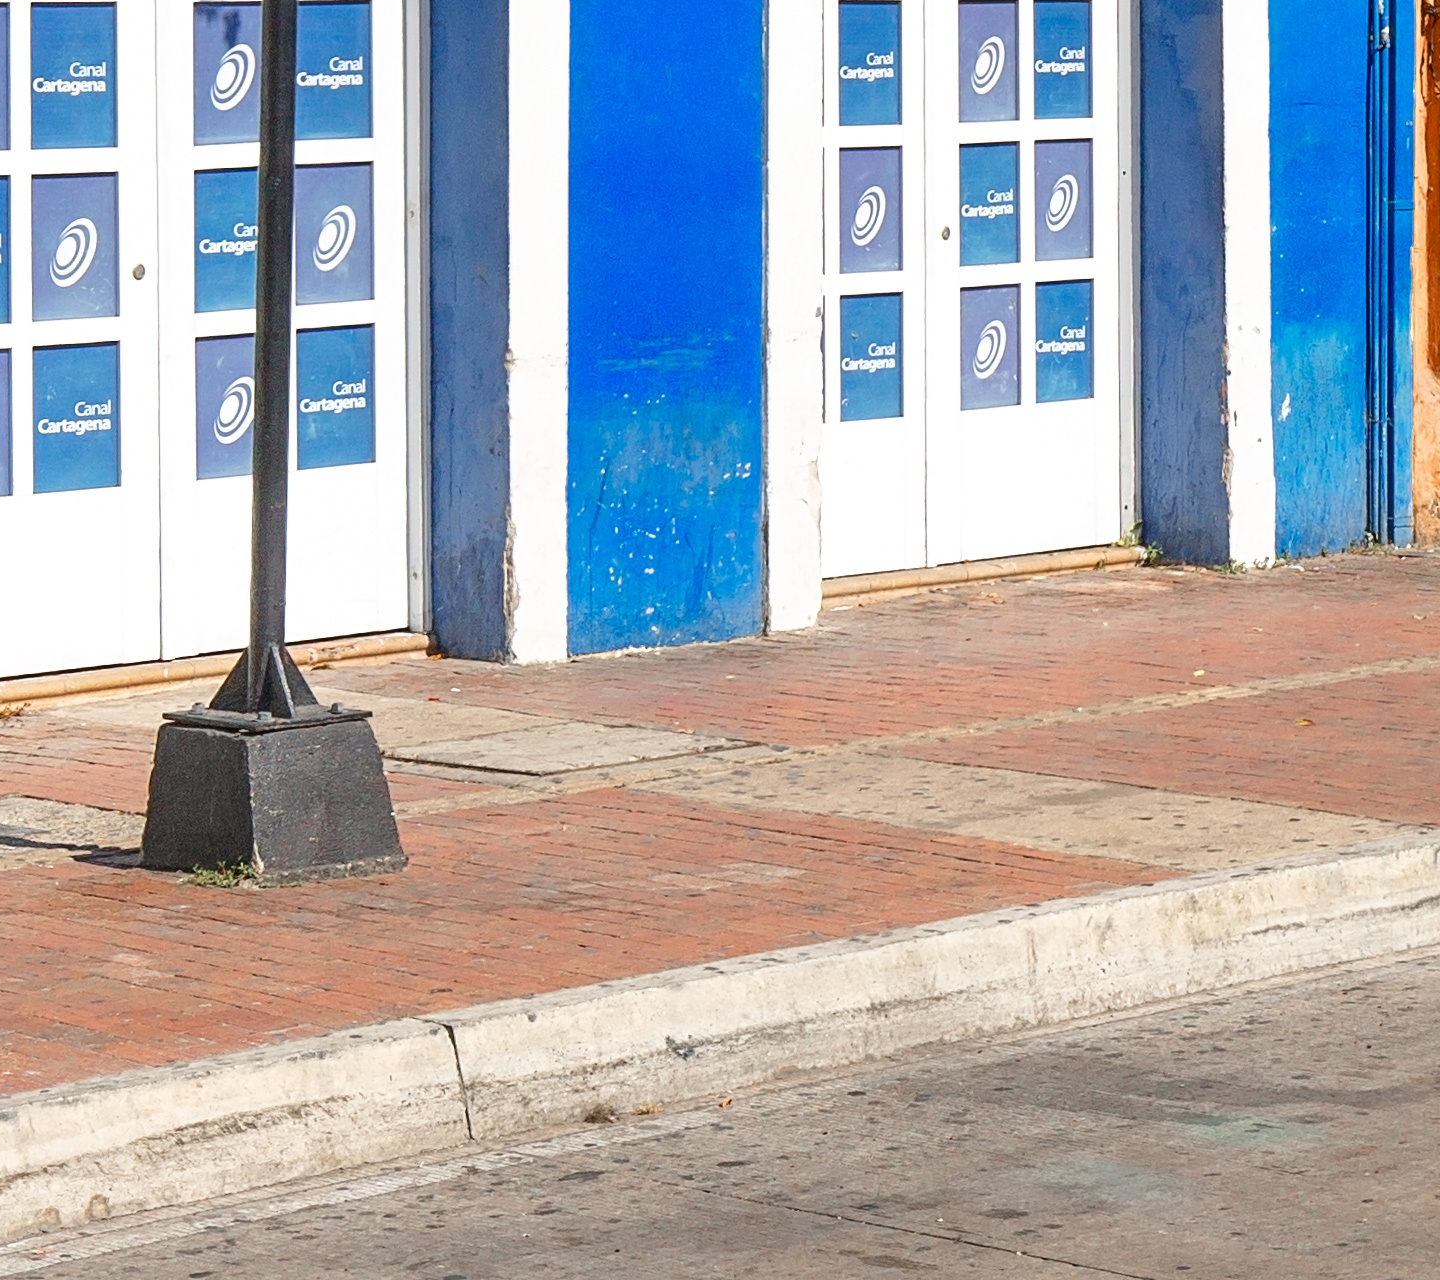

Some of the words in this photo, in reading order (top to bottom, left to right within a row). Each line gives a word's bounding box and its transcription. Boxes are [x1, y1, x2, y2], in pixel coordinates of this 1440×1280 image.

[866, 52, 894, 65] Canal
[1059, 46, 1085, 60] Canal
[69, 61, 107, 77] Canal
[329, 56, 363, 71] Canal
[1034, 60, 1085, 75] Cartagena
[296, 71, 363, 90] Cartagena
[839, 66, 894, 82] Cartagena
[32, 77, 107, 97] Cartagena
[987, 189, 1013, 203] Canal
[961, 203, 1014, 219] Cartagena
[233, 223, 259, 237] Can
[1060, 326, 1085, 340] Canal
[868, 342, 895, 356] Canal
[1035, 339, 1085, 355] Cartagena
[841, 356, 895, 373] Cartagena
[332, 379, 366, 394] Canal
[74, 400, 111, 416] Canal
[299, 395, 366, 414] Cartagena
[37, 417, 111, 437] Cartagena
